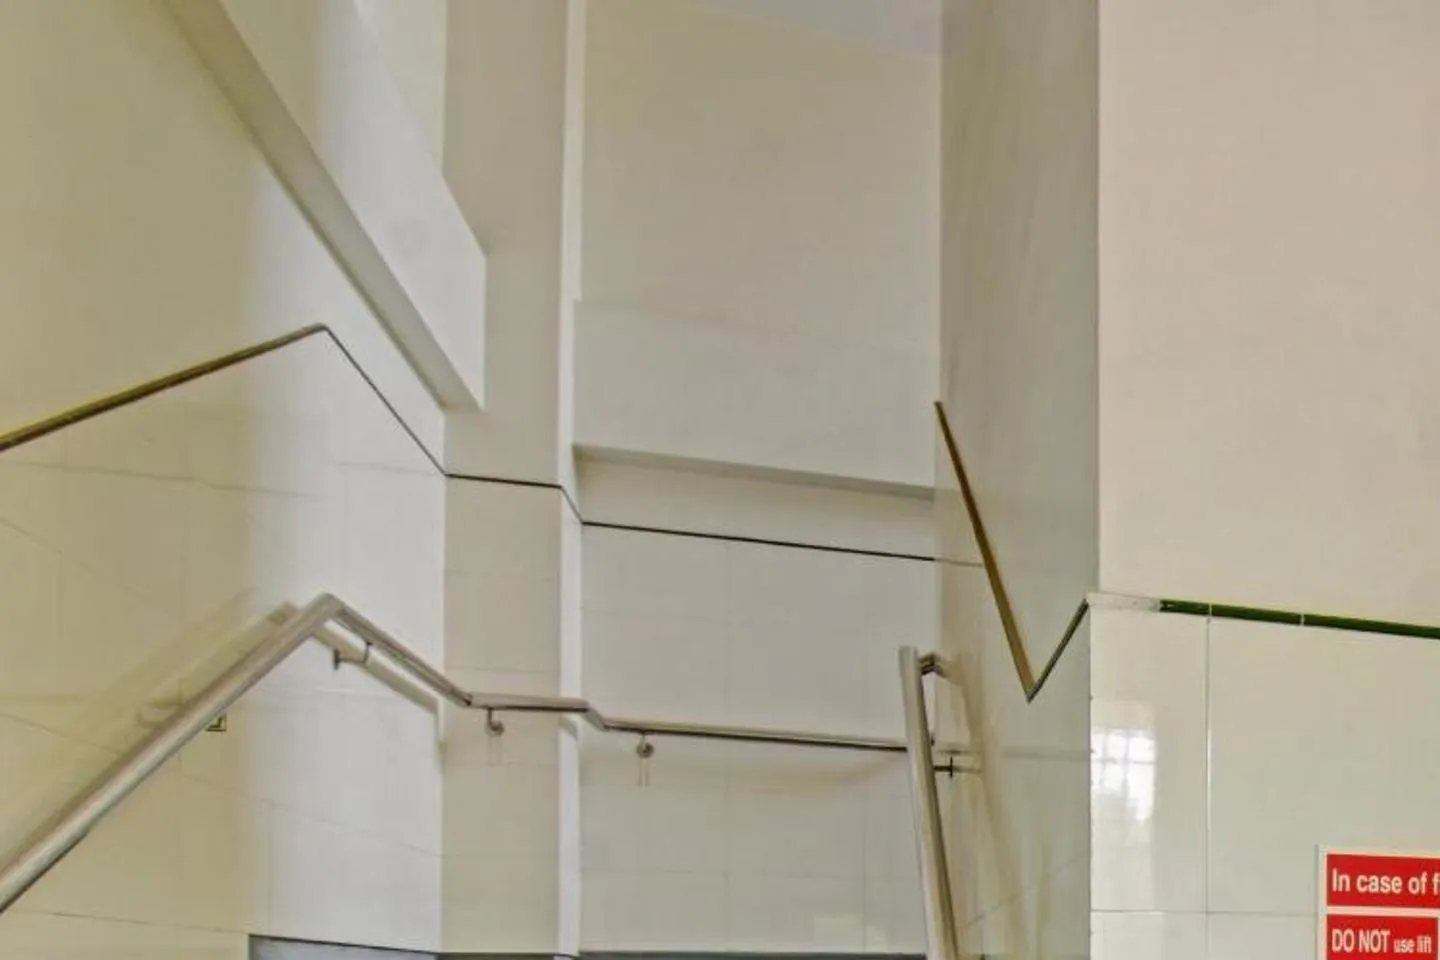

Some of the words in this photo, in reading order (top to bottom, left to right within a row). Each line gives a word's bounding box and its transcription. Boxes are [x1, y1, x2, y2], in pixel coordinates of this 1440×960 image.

[1331, 868, 1351, 892] In
[1356, 874, 1403, 893] case
[1407, 871, 1428, 894] of
[1331, 928, 1355, 952] DO
[1359, 929, 1390, 953] NOT
[1393, 939, 1415, 953] use
[1417, 935, 1432, 953] lift
